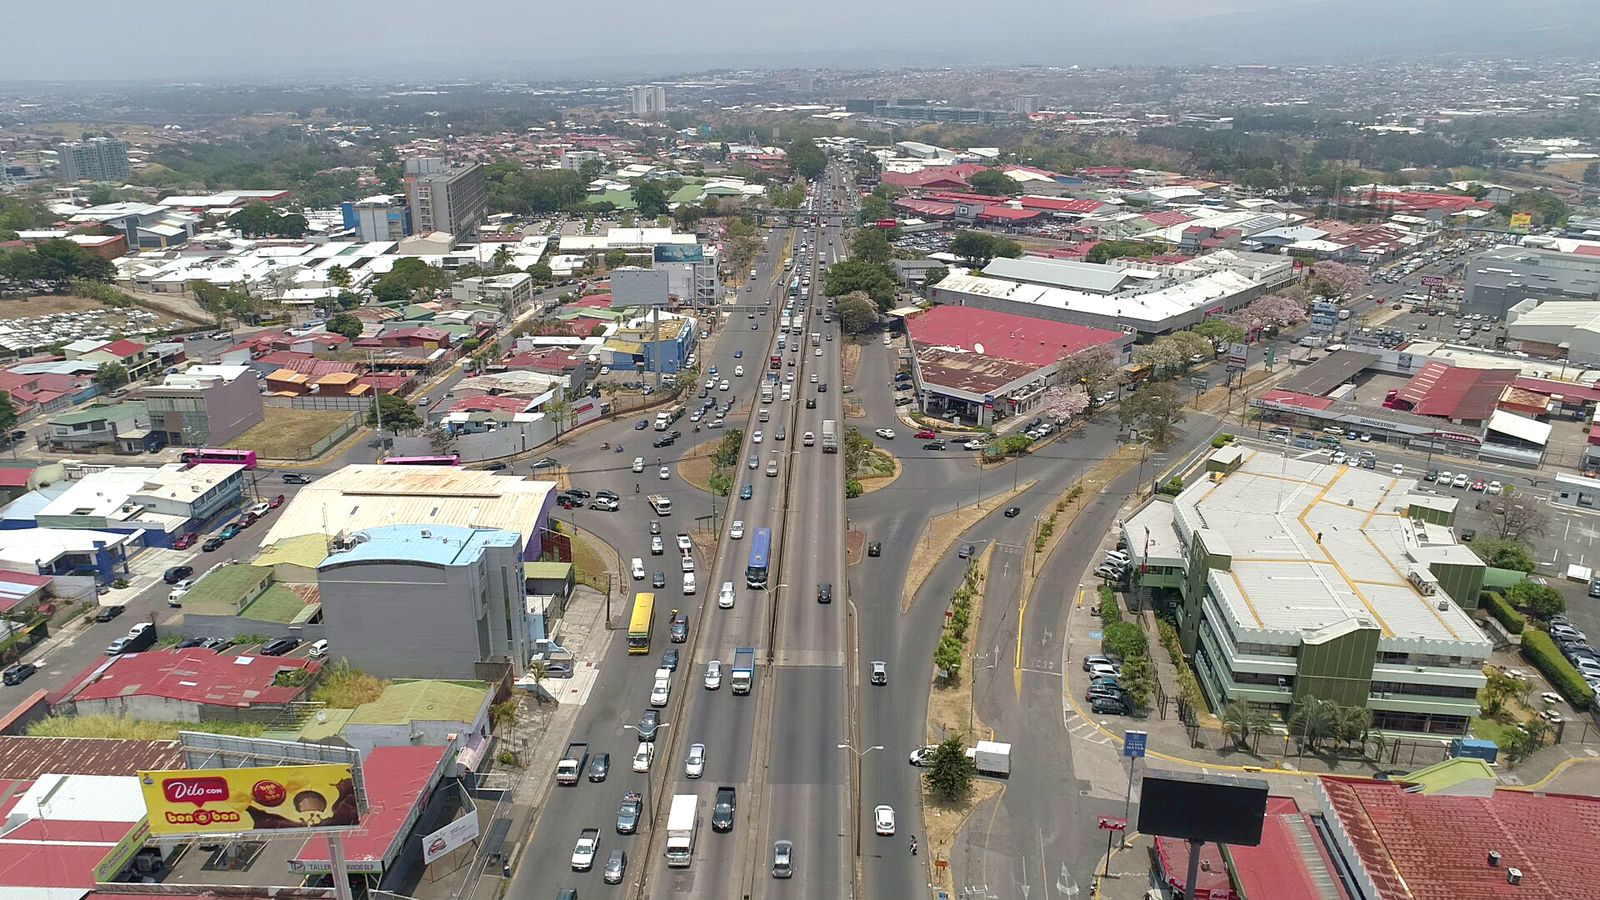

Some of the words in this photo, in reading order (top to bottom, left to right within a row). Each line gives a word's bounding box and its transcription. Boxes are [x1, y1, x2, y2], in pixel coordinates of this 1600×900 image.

[1441, 433, 1476, 442] Firestone
[167, 782, 204, 798] Dilo
[166, 812, 194, 823] bon
[211, 811, 239, 821] bon
